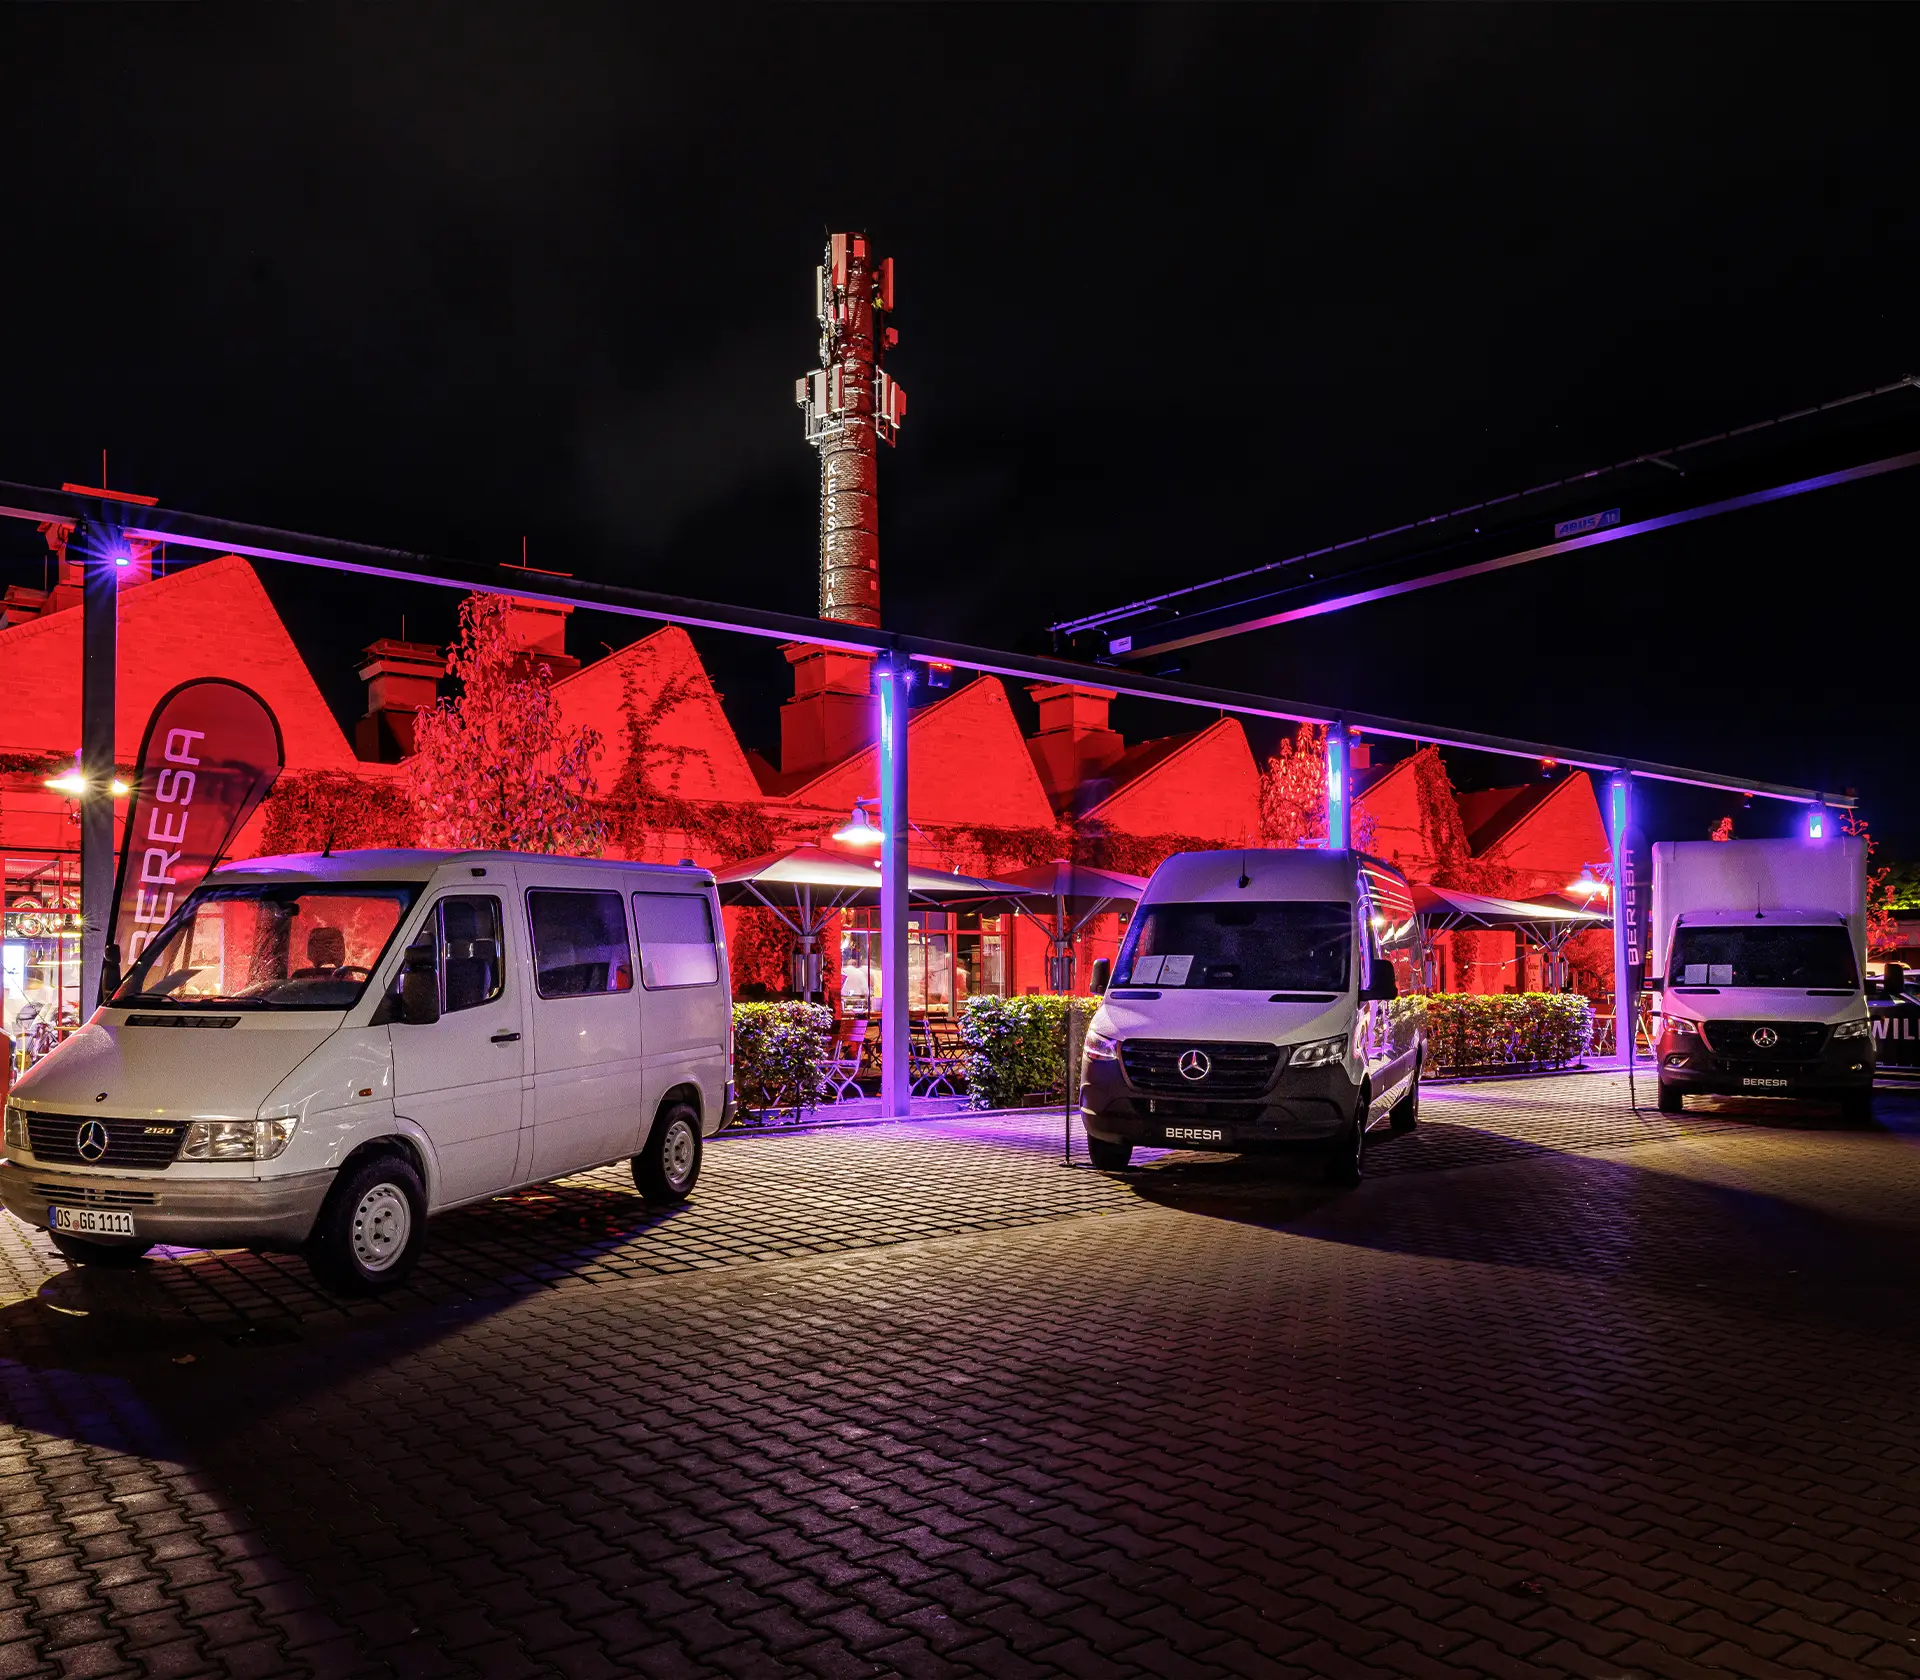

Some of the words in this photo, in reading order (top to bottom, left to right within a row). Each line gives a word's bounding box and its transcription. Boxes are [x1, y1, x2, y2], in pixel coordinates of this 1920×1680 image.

[1559, 517, 1596, 535] ABUS
[128, 728, 205, 967] BERESA
[1625, 849, 1640, 966] BERESA
[1872, 1018, 1920, 1040] WIL
[1743, 1078, 1787, 1087] BERESA
[1165, 1127, 1222, 1140] BERESA
[56, 1209, 71, 1228] OS
[79, 1212, 96, 1230] GG
[98, 1213, 132, 1233] 1111
